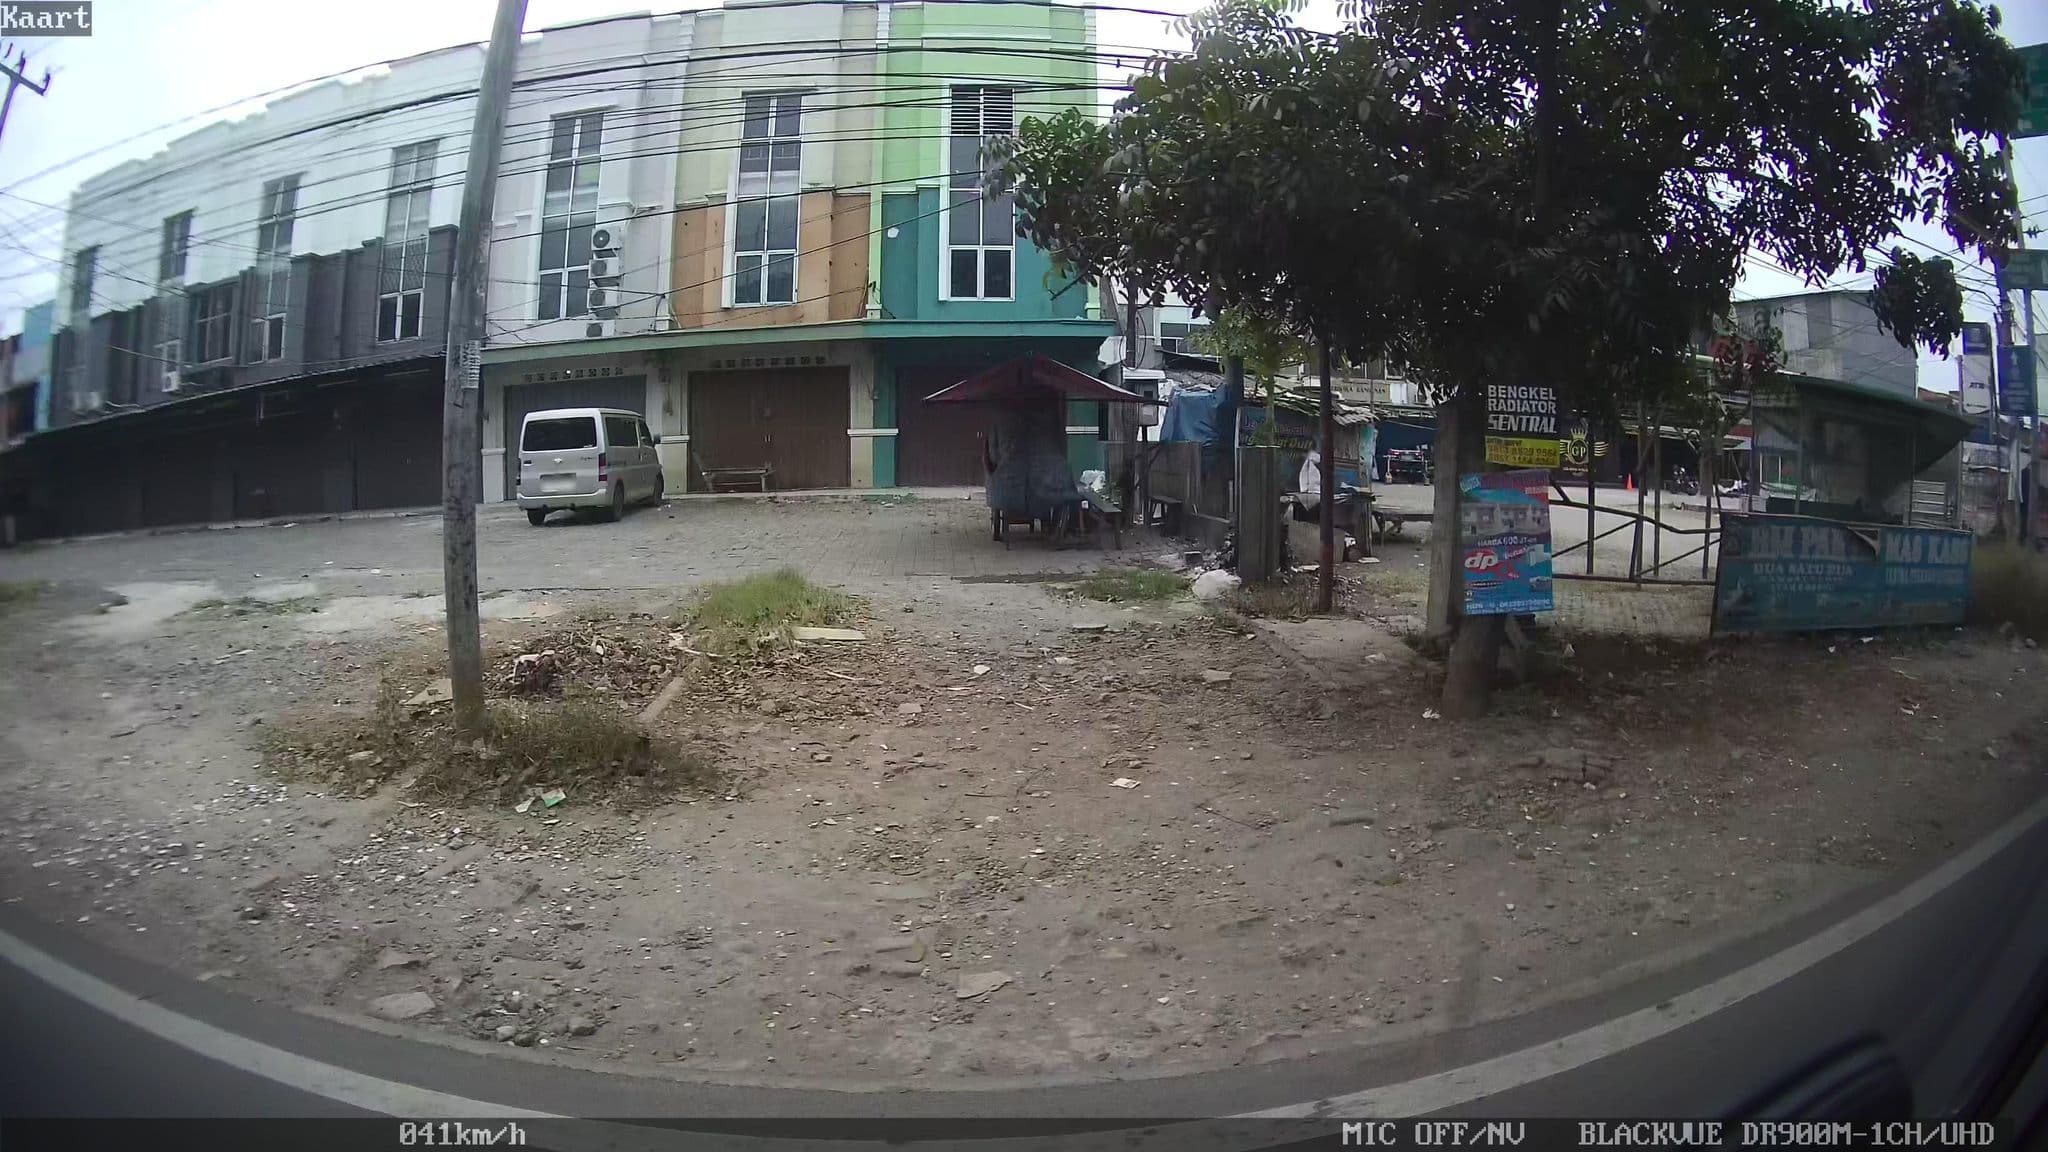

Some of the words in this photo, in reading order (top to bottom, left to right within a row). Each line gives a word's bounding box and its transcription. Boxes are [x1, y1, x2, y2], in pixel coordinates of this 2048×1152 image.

[1487, 384, 1557, 400] BENGKEL
[1487, 398, 1557, 414] RADIATOR
[1487, 413, 1558, 434] SENTRAL
[1464, 552, 1499, 570] dp
